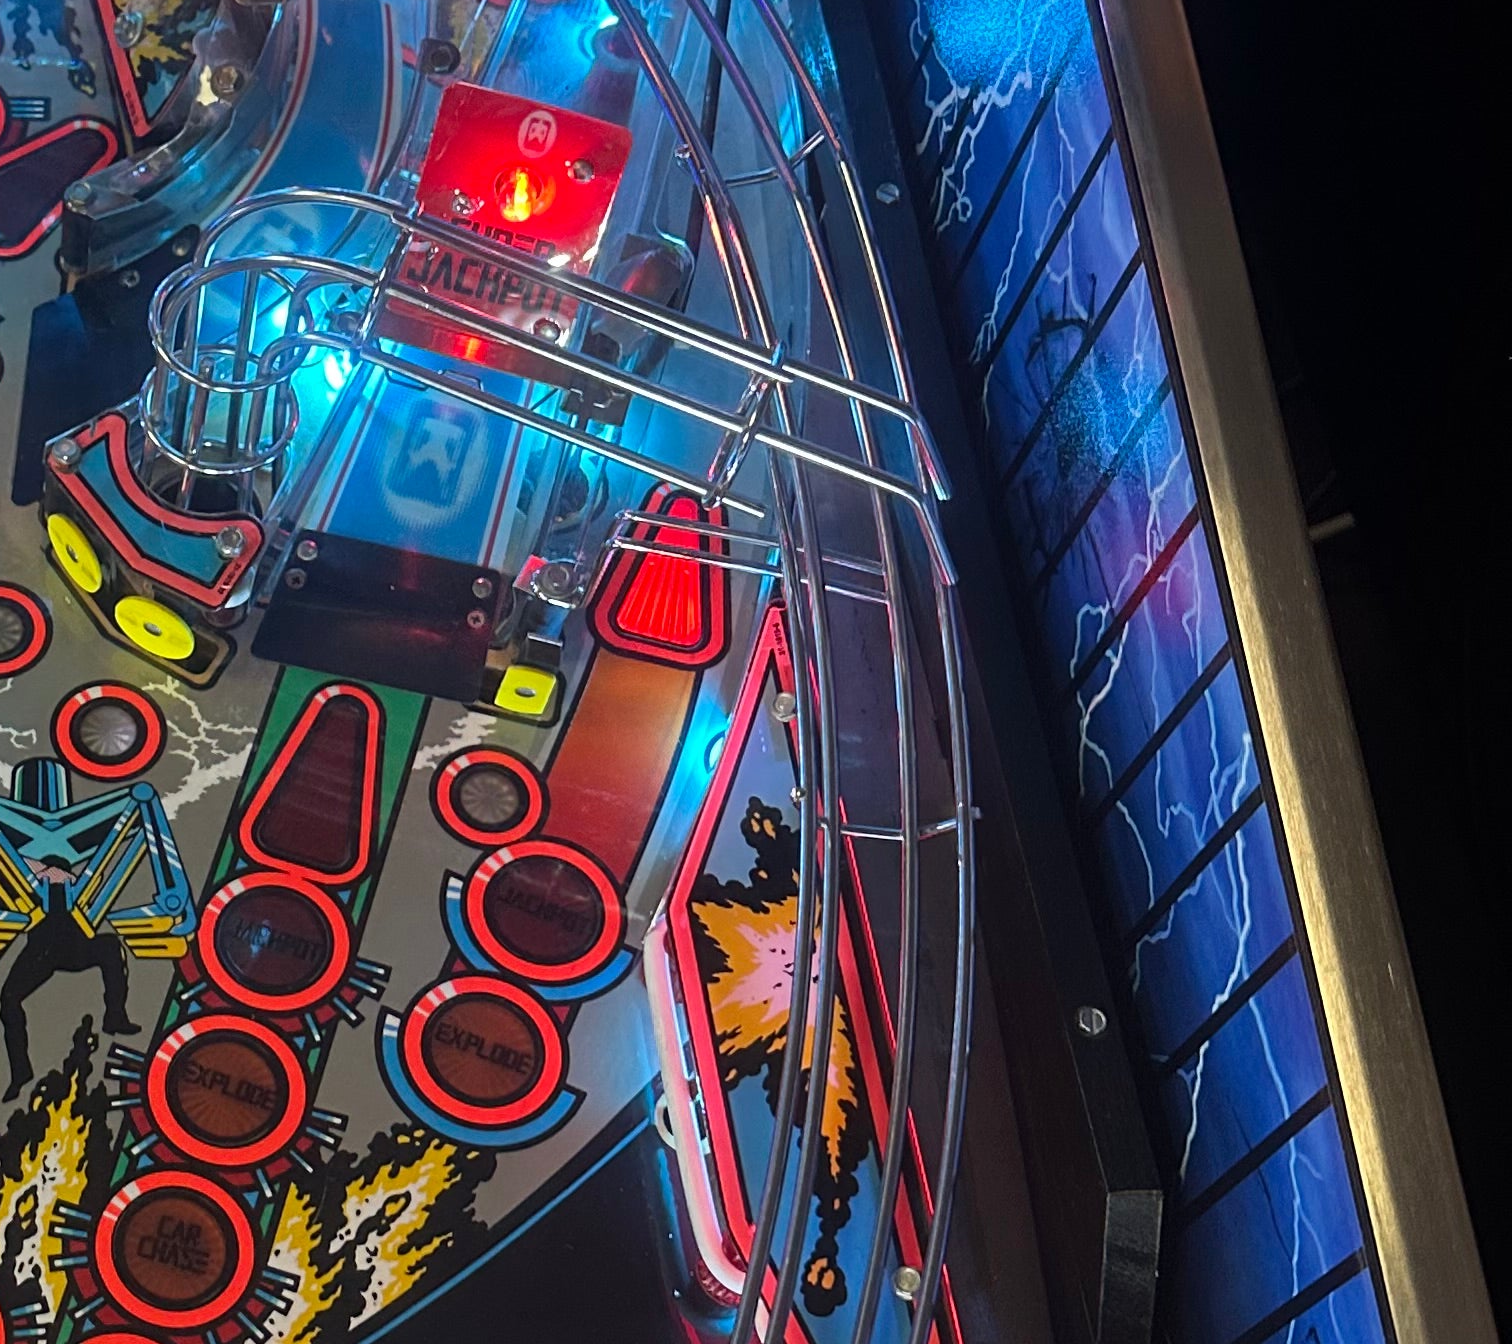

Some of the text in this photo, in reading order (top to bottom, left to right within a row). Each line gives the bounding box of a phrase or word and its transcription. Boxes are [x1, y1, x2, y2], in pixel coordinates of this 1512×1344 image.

[406, 252, 563, 313] JACKPOT
[434, 1020, 534, 1076] EXPLODE
[185, 1060, 277, 1113] EXPLODE
[156, 1215, 202, 1241] CAR
[137, 1234, 211, 1276] CHASE
